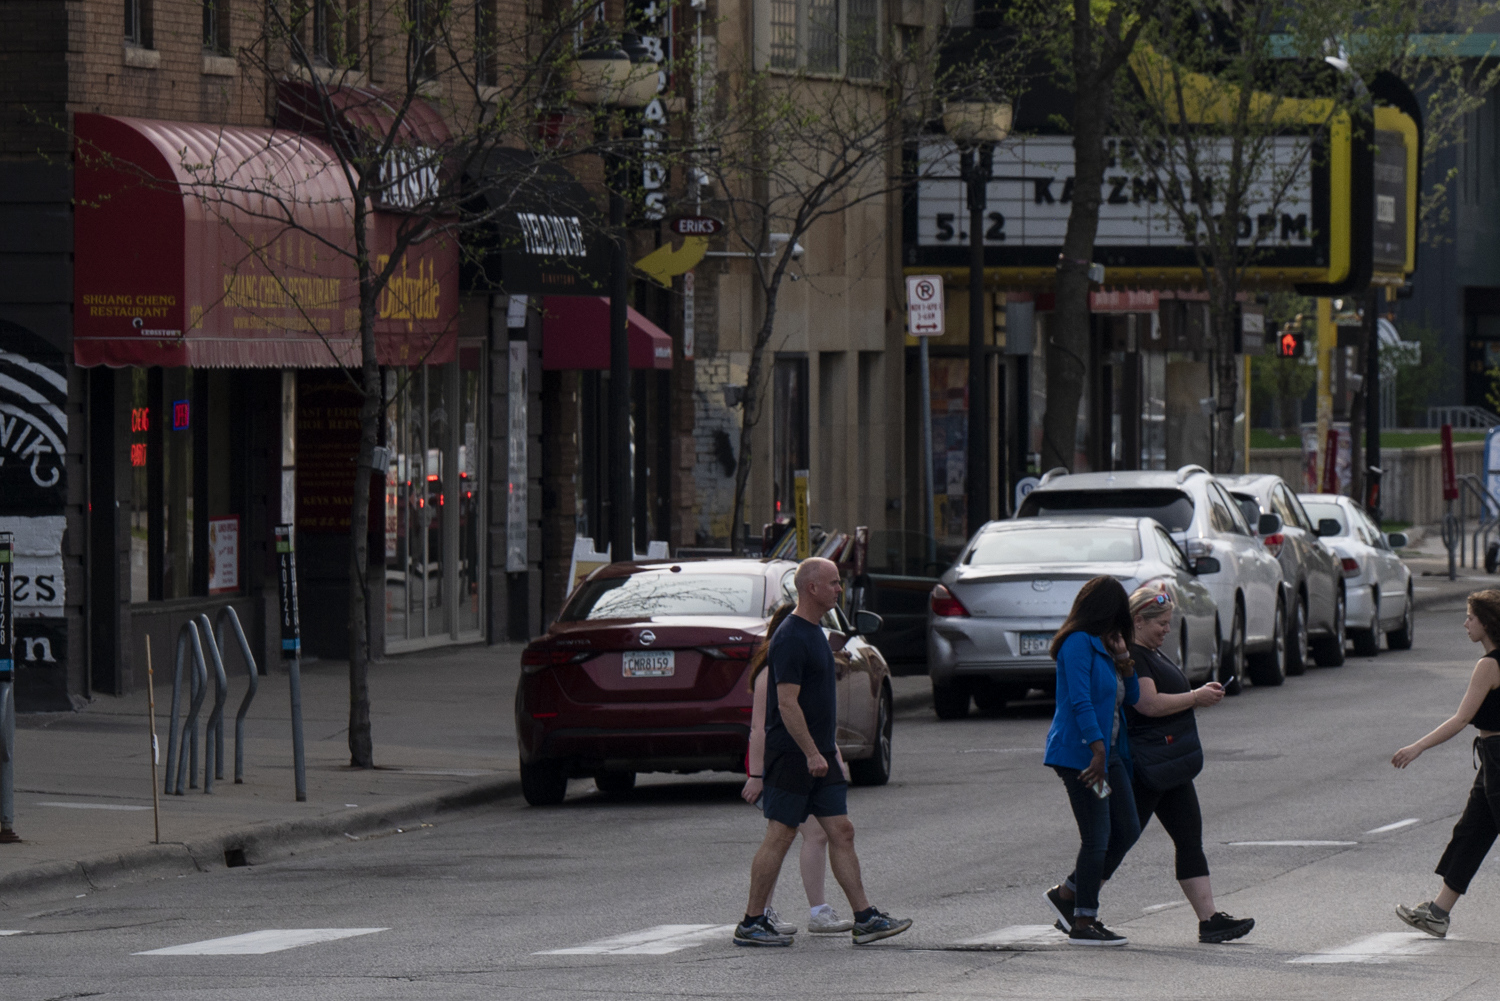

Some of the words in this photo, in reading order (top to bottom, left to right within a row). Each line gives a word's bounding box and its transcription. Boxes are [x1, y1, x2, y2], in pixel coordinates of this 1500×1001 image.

[83, 295, 134, 306] SHUANG
[136, 295, 177, 306] CHENG
[90, 306, 169, 318] RESTAURANT
[628, 658, 669, 672] CMR8159
